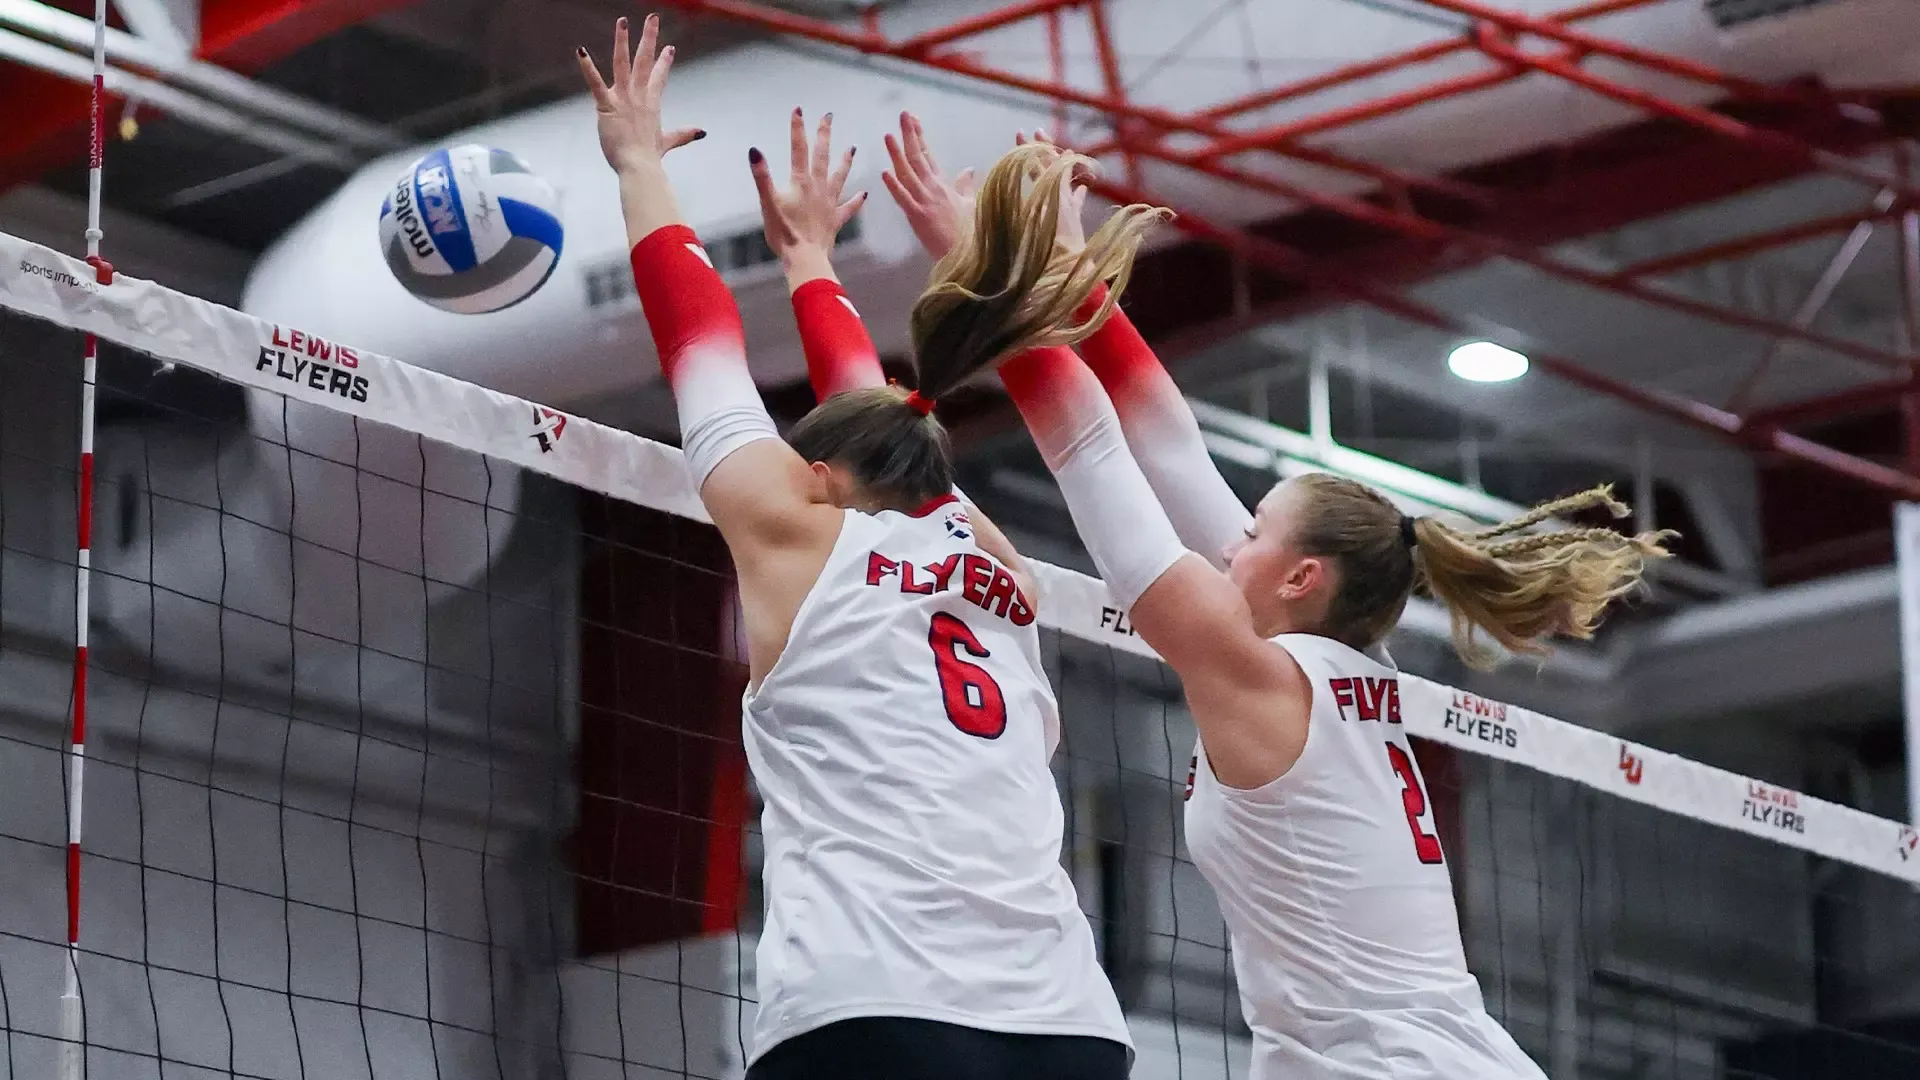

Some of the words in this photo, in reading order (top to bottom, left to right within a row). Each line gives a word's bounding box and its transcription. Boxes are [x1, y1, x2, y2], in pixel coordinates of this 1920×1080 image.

[395, 173, 434, 258] molten
[20, 260, 53, 279] sports
[272, 324, 358, 369] LEWIS
[256, 345, 369, 403] FLYERS
[866, 551, 1035, 626] FLYERS
[928, 611, 1007, 740] 6
[1444, 708, 1517, 748] FLYERS
[1453, 692, 1507, 722] LEWIS
[1385, 741, 1443, 865] 2
[1743, 799, 1805, 834] FLYERS
